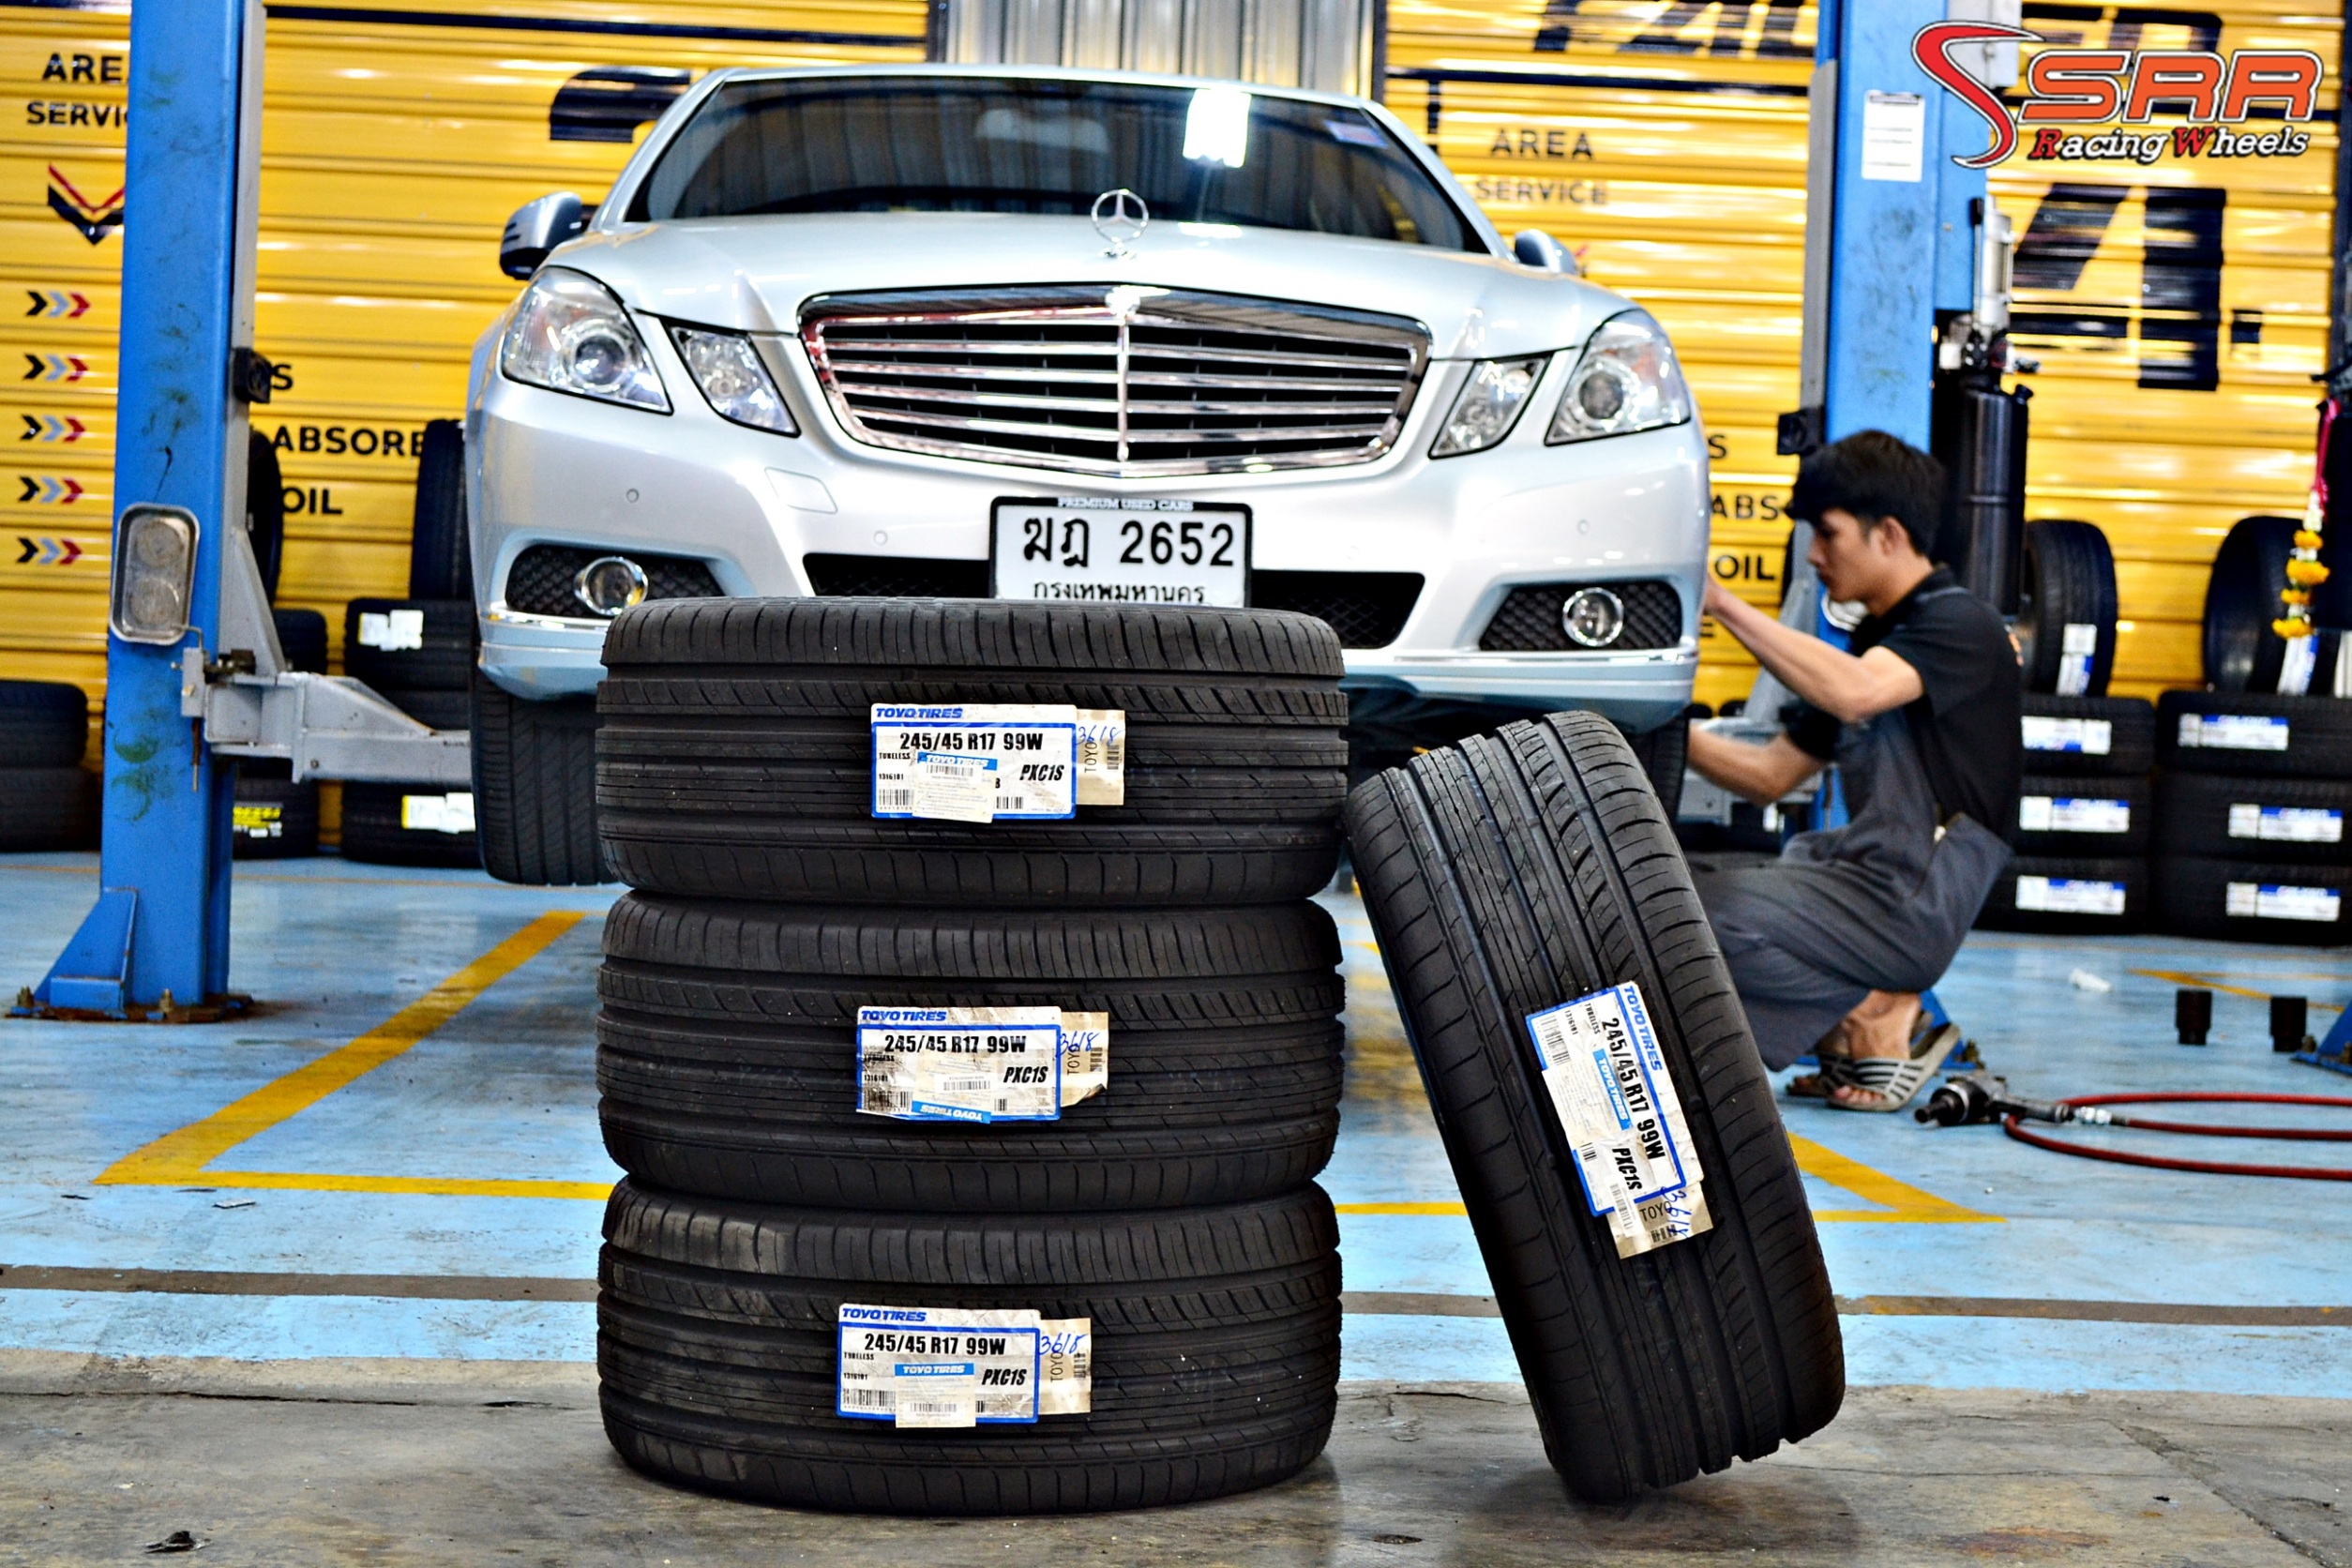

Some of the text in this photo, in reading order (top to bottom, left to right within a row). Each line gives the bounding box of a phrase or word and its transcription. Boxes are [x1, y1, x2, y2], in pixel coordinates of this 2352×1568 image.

[42, 53, 129, 83] ARE
[26, 101, 128, 128] SERVI
[1491, 128, 1593, 159] AREA
[1476, 178, 1607, 204] SERVICE
[274, 426, 425, 457] ABSORB
[282, 487, 343, 515] OIL
[1057, 497, 1194, 512] PREMIUM USED CARS
[1711, 494, 1780, 521] ABS
[1120, 520, 1235, 567] 2652
[1714, 555, 1775, 580] OIL
[1033, 581, 1207, 603] กรงเทพมหานคร
[876, 707, 964, 719] TOYO TIRES
[899, 732, 1044, 751] 245/45 R17 99W
[926, 754, 956, 764] TOYO
[1019, 764, 1065, 782] PXC1S
[861, 1010, 947, 1022] TOYO TIRES
[1623, 985, 1664, 1071] TOYO TIRES
[884, 1034, 1028, 1054] 245/45 R17 99W
[1003, 1066, 1049, 1084] PXC1S
[1598, 1057, 1618, 1090] TOYO
[1602, 1017, 1666, 1160] 245/45 R17 99W
[842, 1307, 927, 1322] TOYO TIRES
[864, 1333, 1006, 1356] 245/45 R17 99W
[902, 1364, 966, 1375] TOYO TIRES
[981, 1369, 1028, 1386] PXC1S
